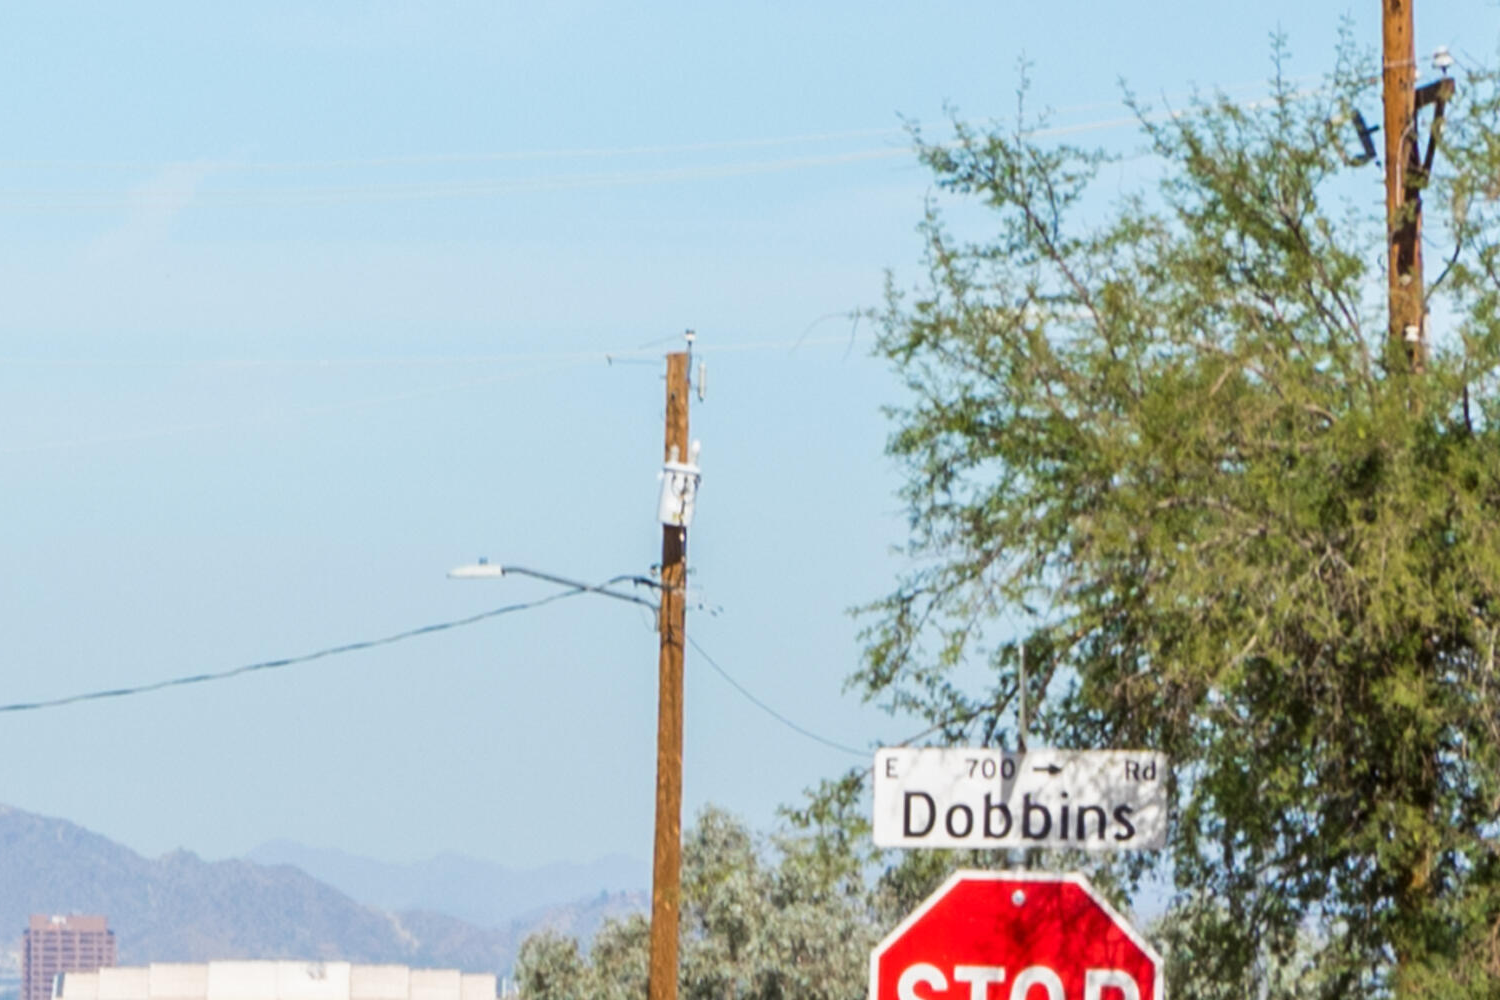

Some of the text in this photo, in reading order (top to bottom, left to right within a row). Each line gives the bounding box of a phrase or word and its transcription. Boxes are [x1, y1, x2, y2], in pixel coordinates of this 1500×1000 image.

[885, 757, 1157, 781] E 700 Rd
[902, 790, 1137, 842] Dobbins
